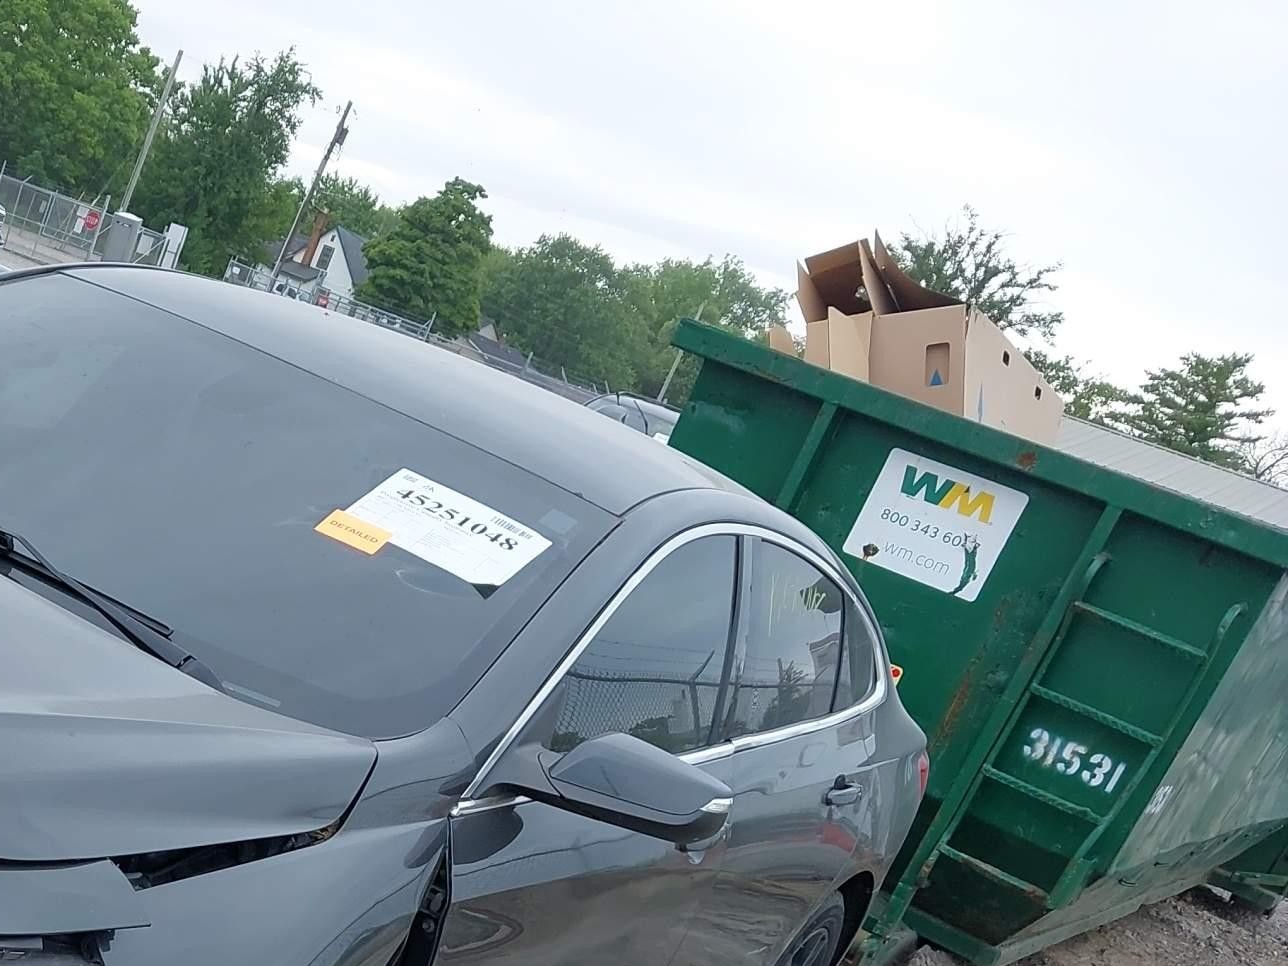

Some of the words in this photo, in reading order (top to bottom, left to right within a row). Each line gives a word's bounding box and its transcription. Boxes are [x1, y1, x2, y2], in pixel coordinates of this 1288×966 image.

[900, 464, 996, 525] WM
[328, 519, 379, 544] DETAILED
[395, 489, 519, 551] 45251048
[880, 508, 910, 528] 800
[909, 519, 940, 539] 343
[884, 541, 951, 576] wm.com
[1023, 728, 1127, 793] 31531
